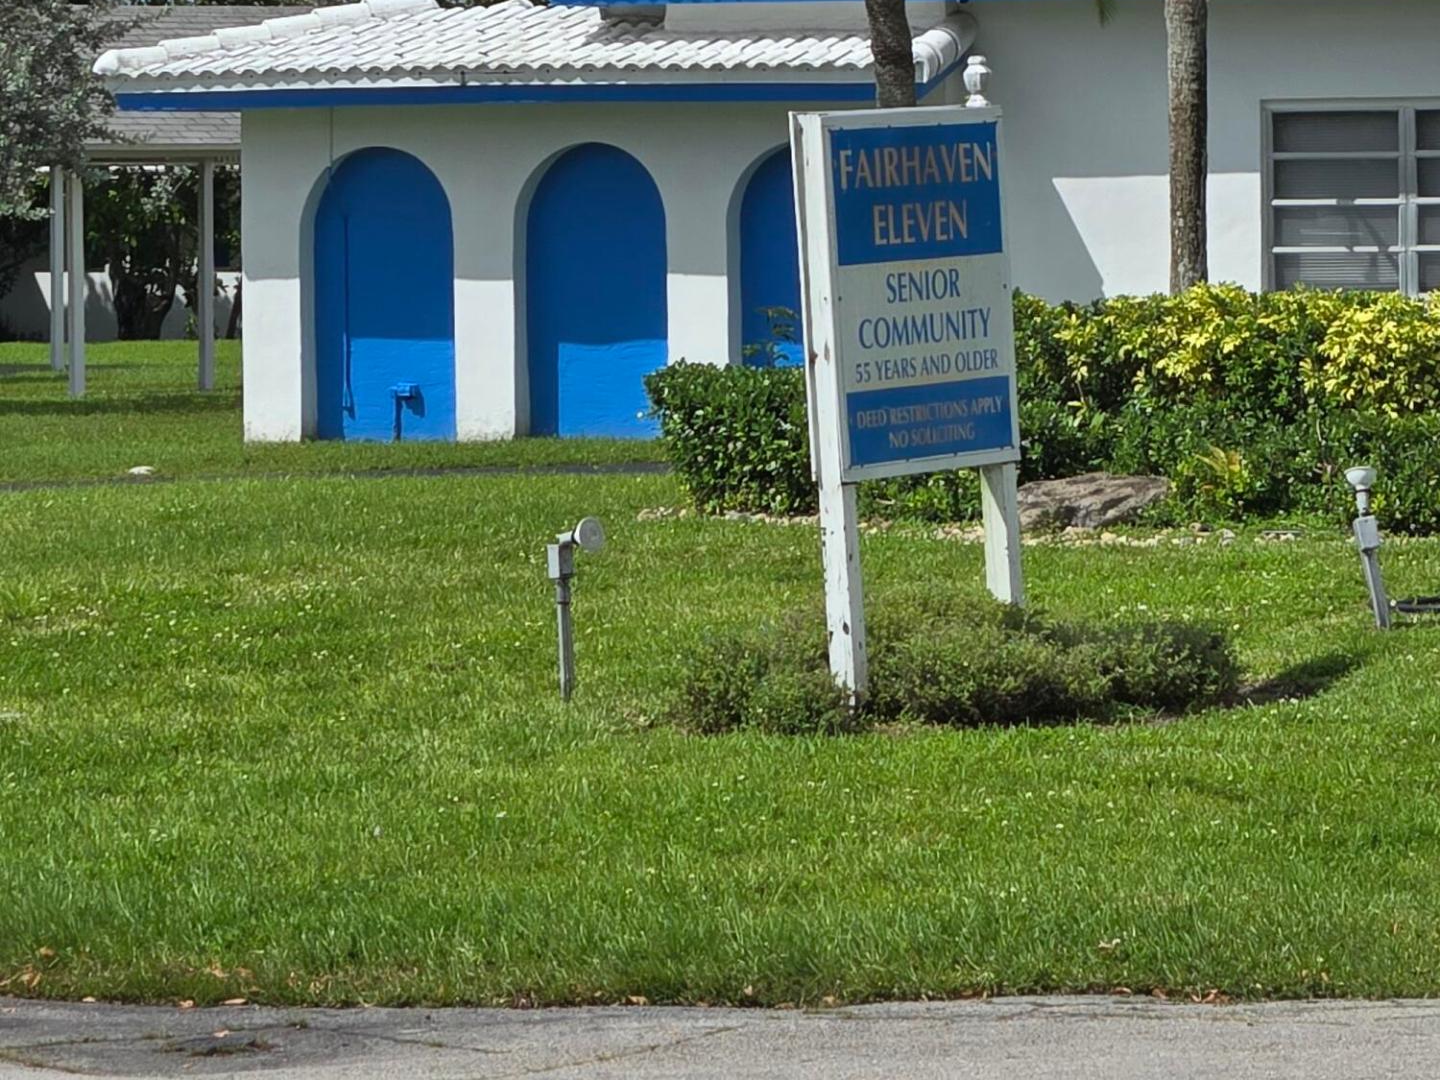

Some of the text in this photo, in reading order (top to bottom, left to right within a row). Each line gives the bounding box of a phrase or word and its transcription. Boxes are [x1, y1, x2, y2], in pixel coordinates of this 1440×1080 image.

[838, 141, 993, 190] FAIRHAVEN
[872, 199, 968, 246] ELEVEN
[886, 268, 961, 304] SENIOR
[858, 306, 991, 349] COMMUNITY
[855, 348, 998, 384] 55 YEARS AND OLDER
[856, 395, 1003, 429] DEED RESTRICTIONS APPLY
[888, 423, 975, 449] NO SOLICITING
